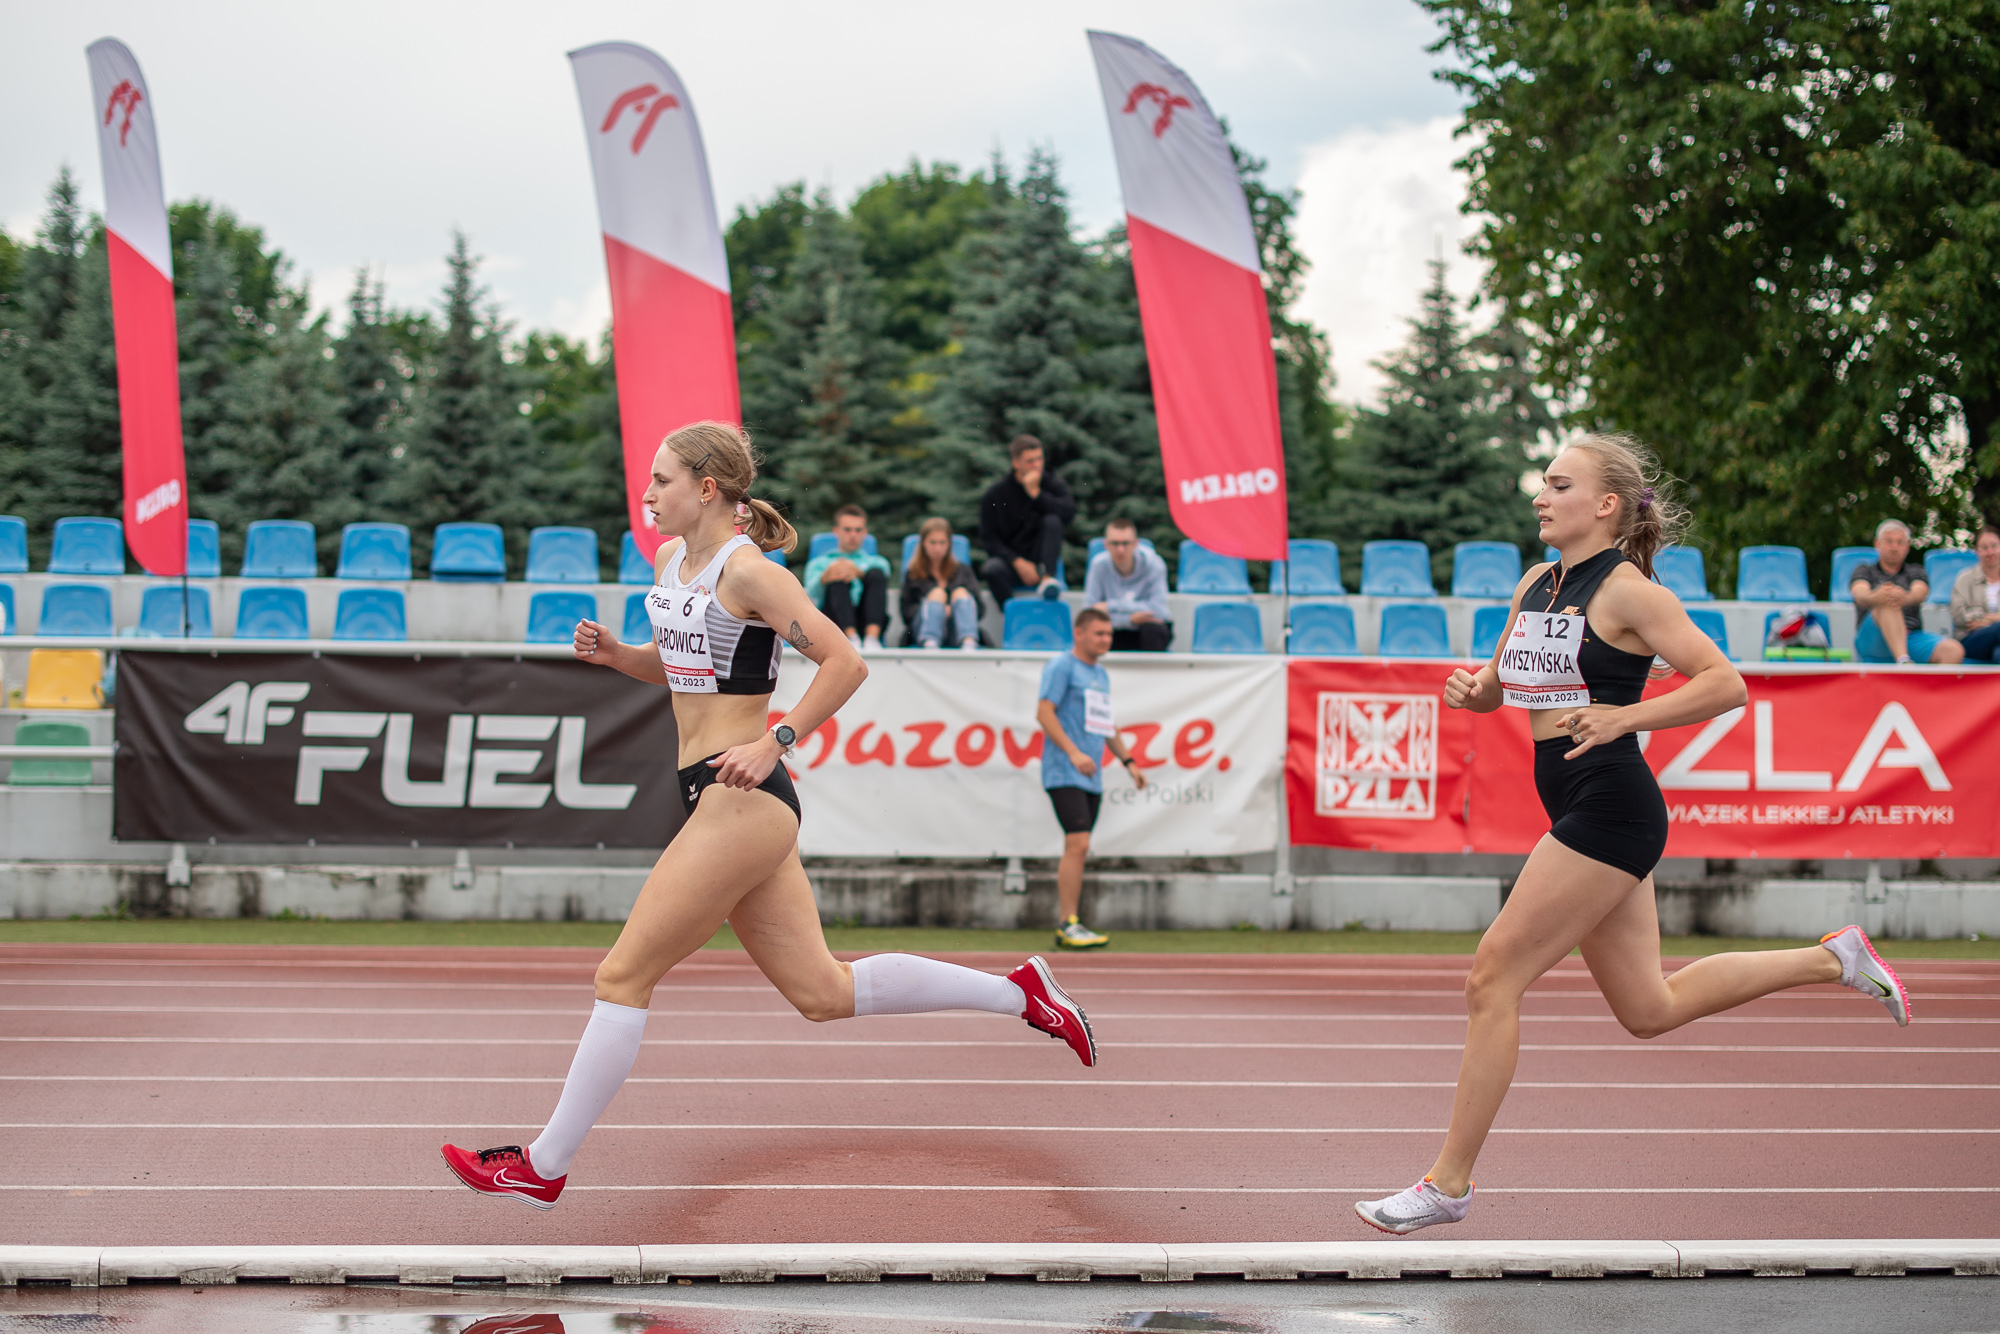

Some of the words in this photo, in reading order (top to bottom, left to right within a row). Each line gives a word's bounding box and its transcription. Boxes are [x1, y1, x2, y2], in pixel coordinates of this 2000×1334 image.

[652, 596, 671, 610] FUEL
[682, 596, 696, 617] 6
[1543, 617, 1570, 640] 12
[1501, 646, 1576, 674] MYSZYŃSKA
[682, 677, 706, 687] 2023
[1509, 691, 1553, 704] WARSZAWA
[1554, 692, 1579, 702] 2023
[184, 681, 311, 744] 4F
[295, 710, 638, 809] FUEL
[1636, 700, 1953, 792] ZLA
[1145, 782, 1214, 805] Polski
[1323, 776, 1428, 811] PZLA
[1752, 804, 1845, 825] LEKKIEJ
[1850, 804, 1954, 825] ATLETYKI
